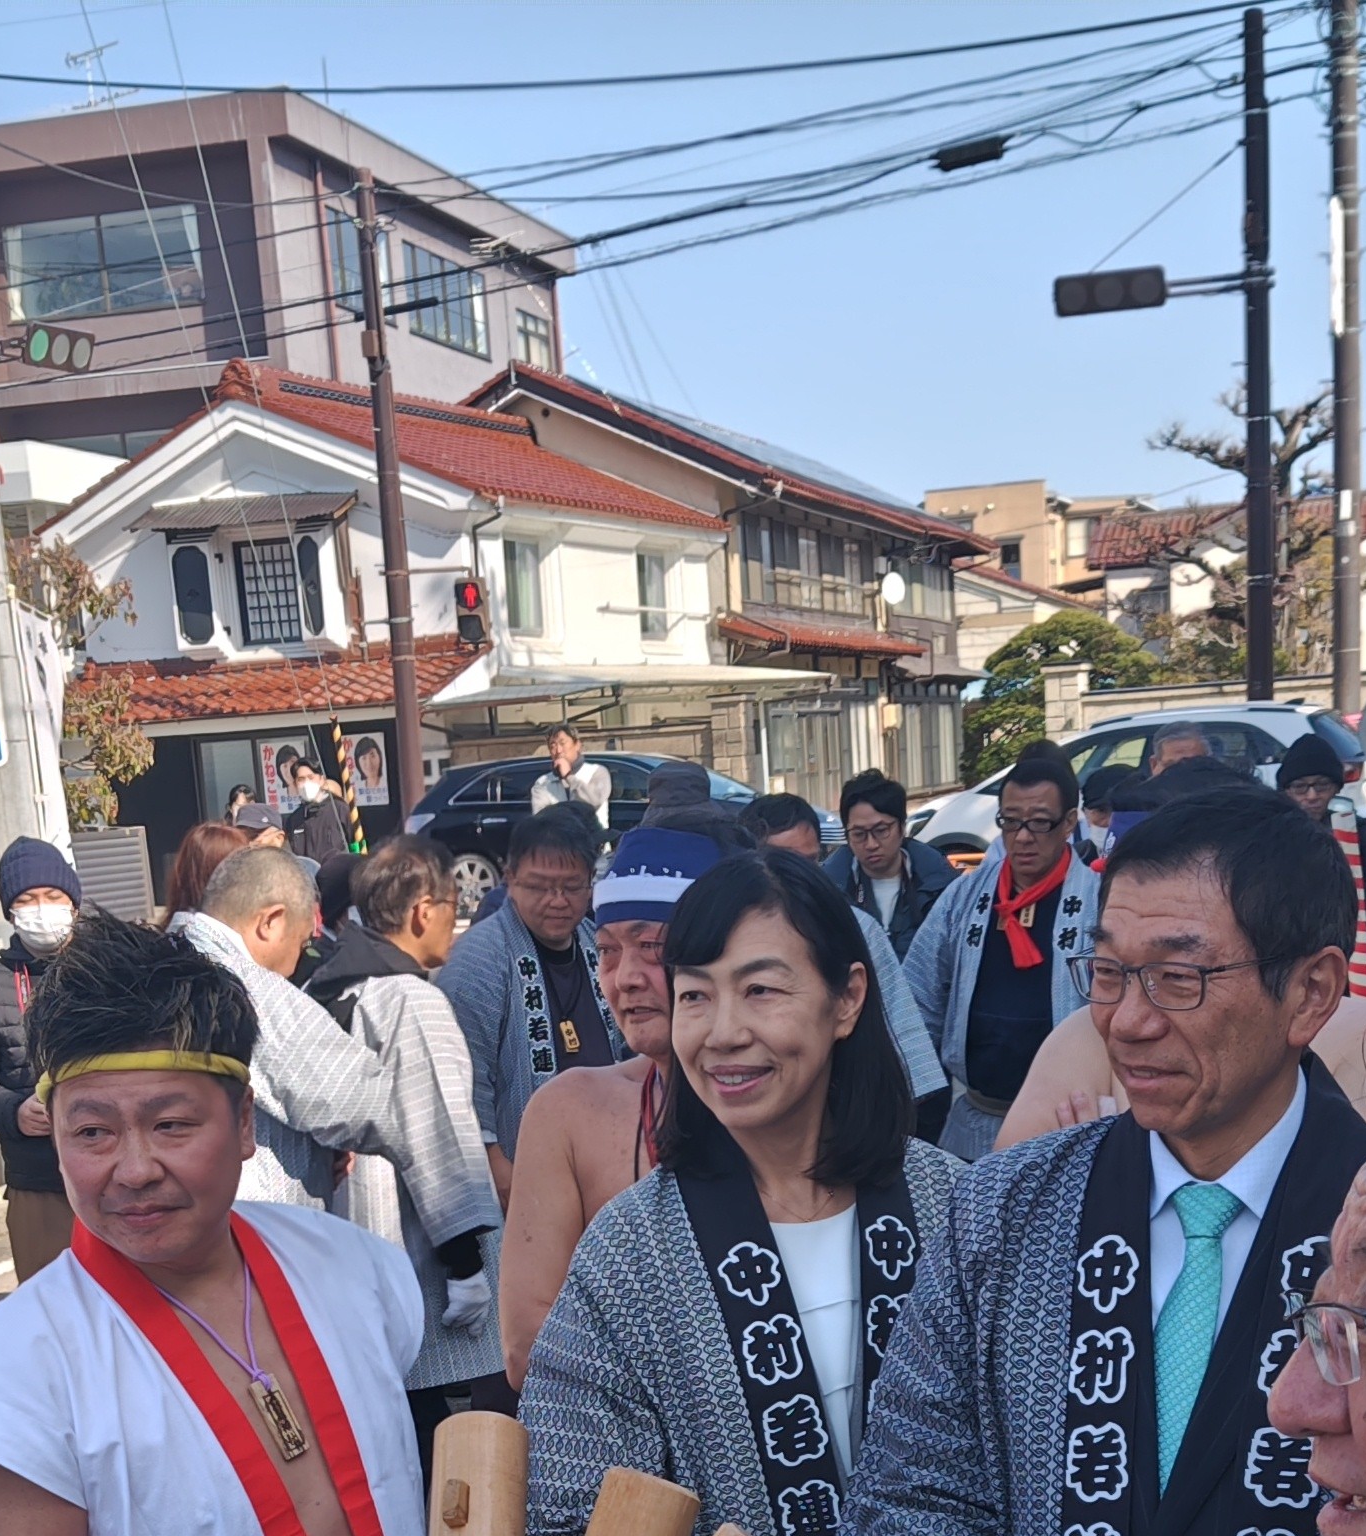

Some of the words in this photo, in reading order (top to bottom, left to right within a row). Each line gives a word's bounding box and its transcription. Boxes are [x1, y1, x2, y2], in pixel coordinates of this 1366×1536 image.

[1056, 895, 1083, 951] 中村
[517, 956, 554, 1074] 中村若連
